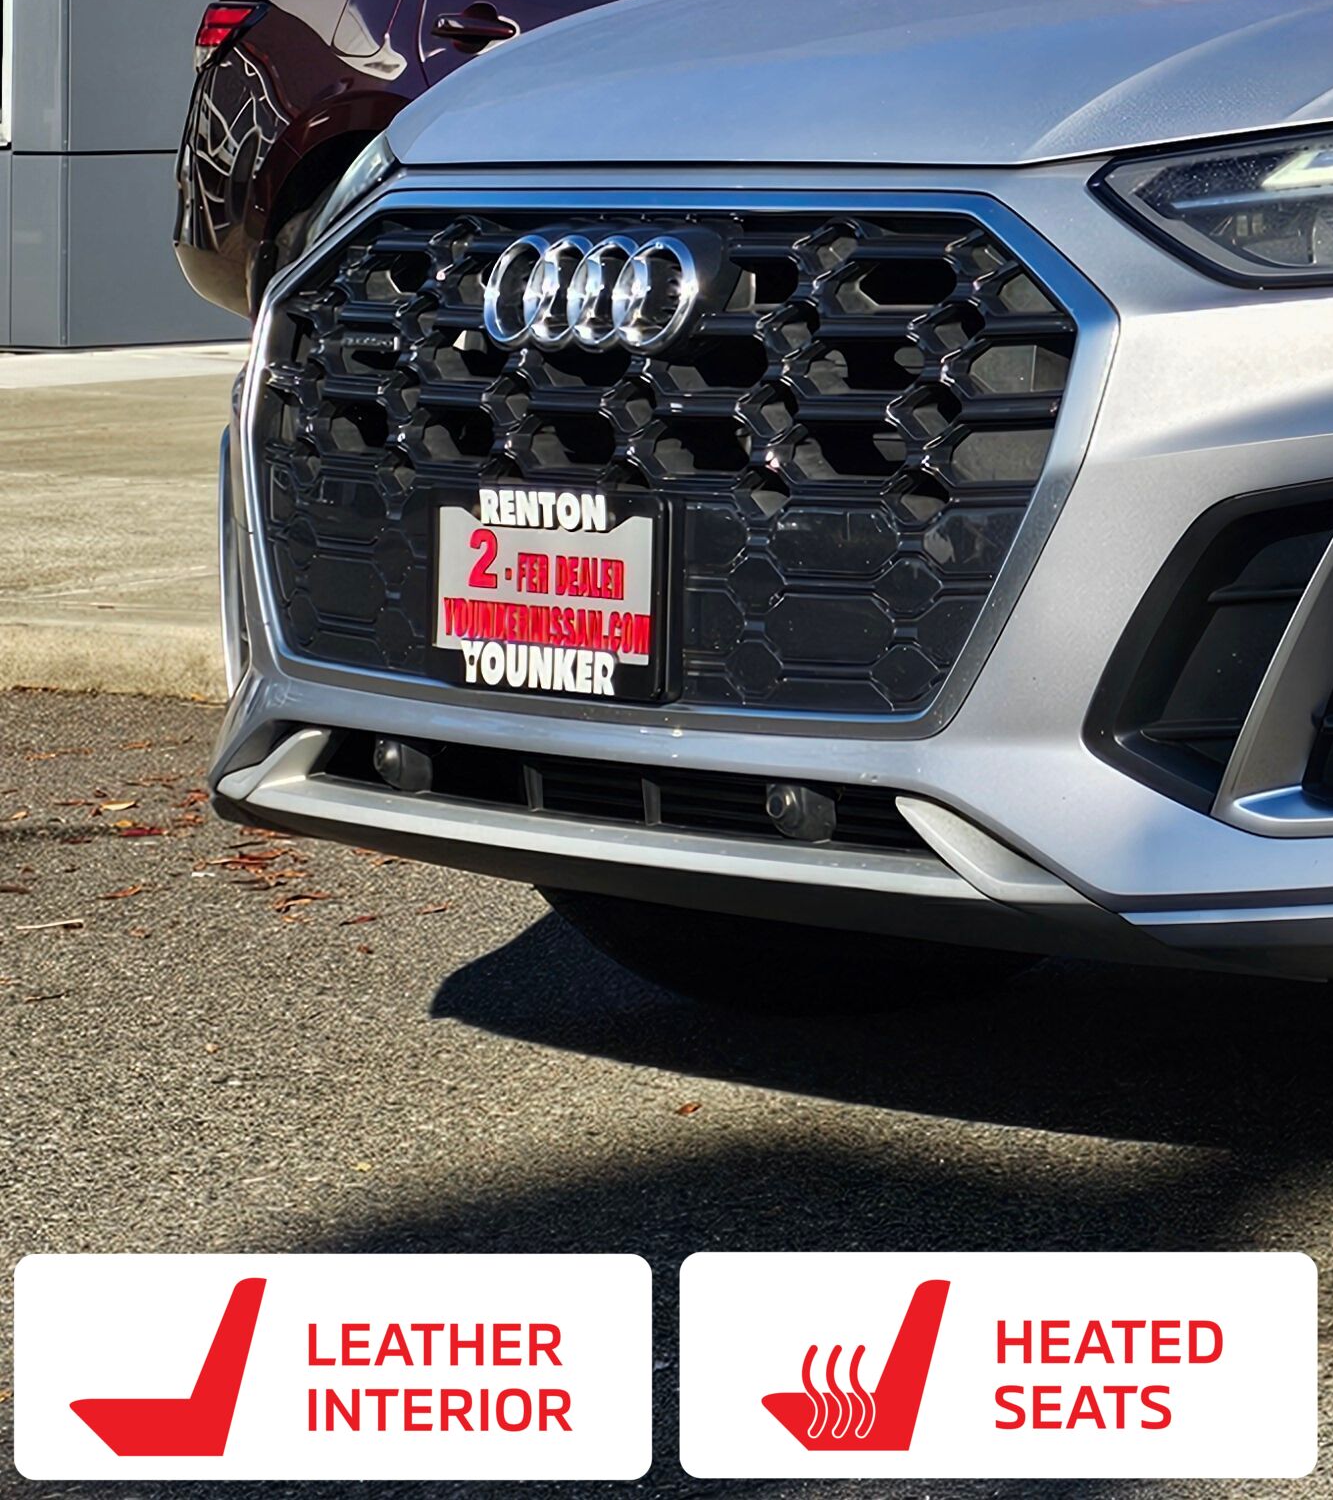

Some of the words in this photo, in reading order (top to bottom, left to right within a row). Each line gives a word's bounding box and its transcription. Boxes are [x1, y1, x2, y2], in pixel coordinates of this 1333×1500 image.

[479, 489, 607, 531] RENTON
[555, 554, 625, 600] DEALER
[443, 596, 651, 655] YOUNKERNISSAN.COM
[461, 639, 616, 696] YOUNKER
